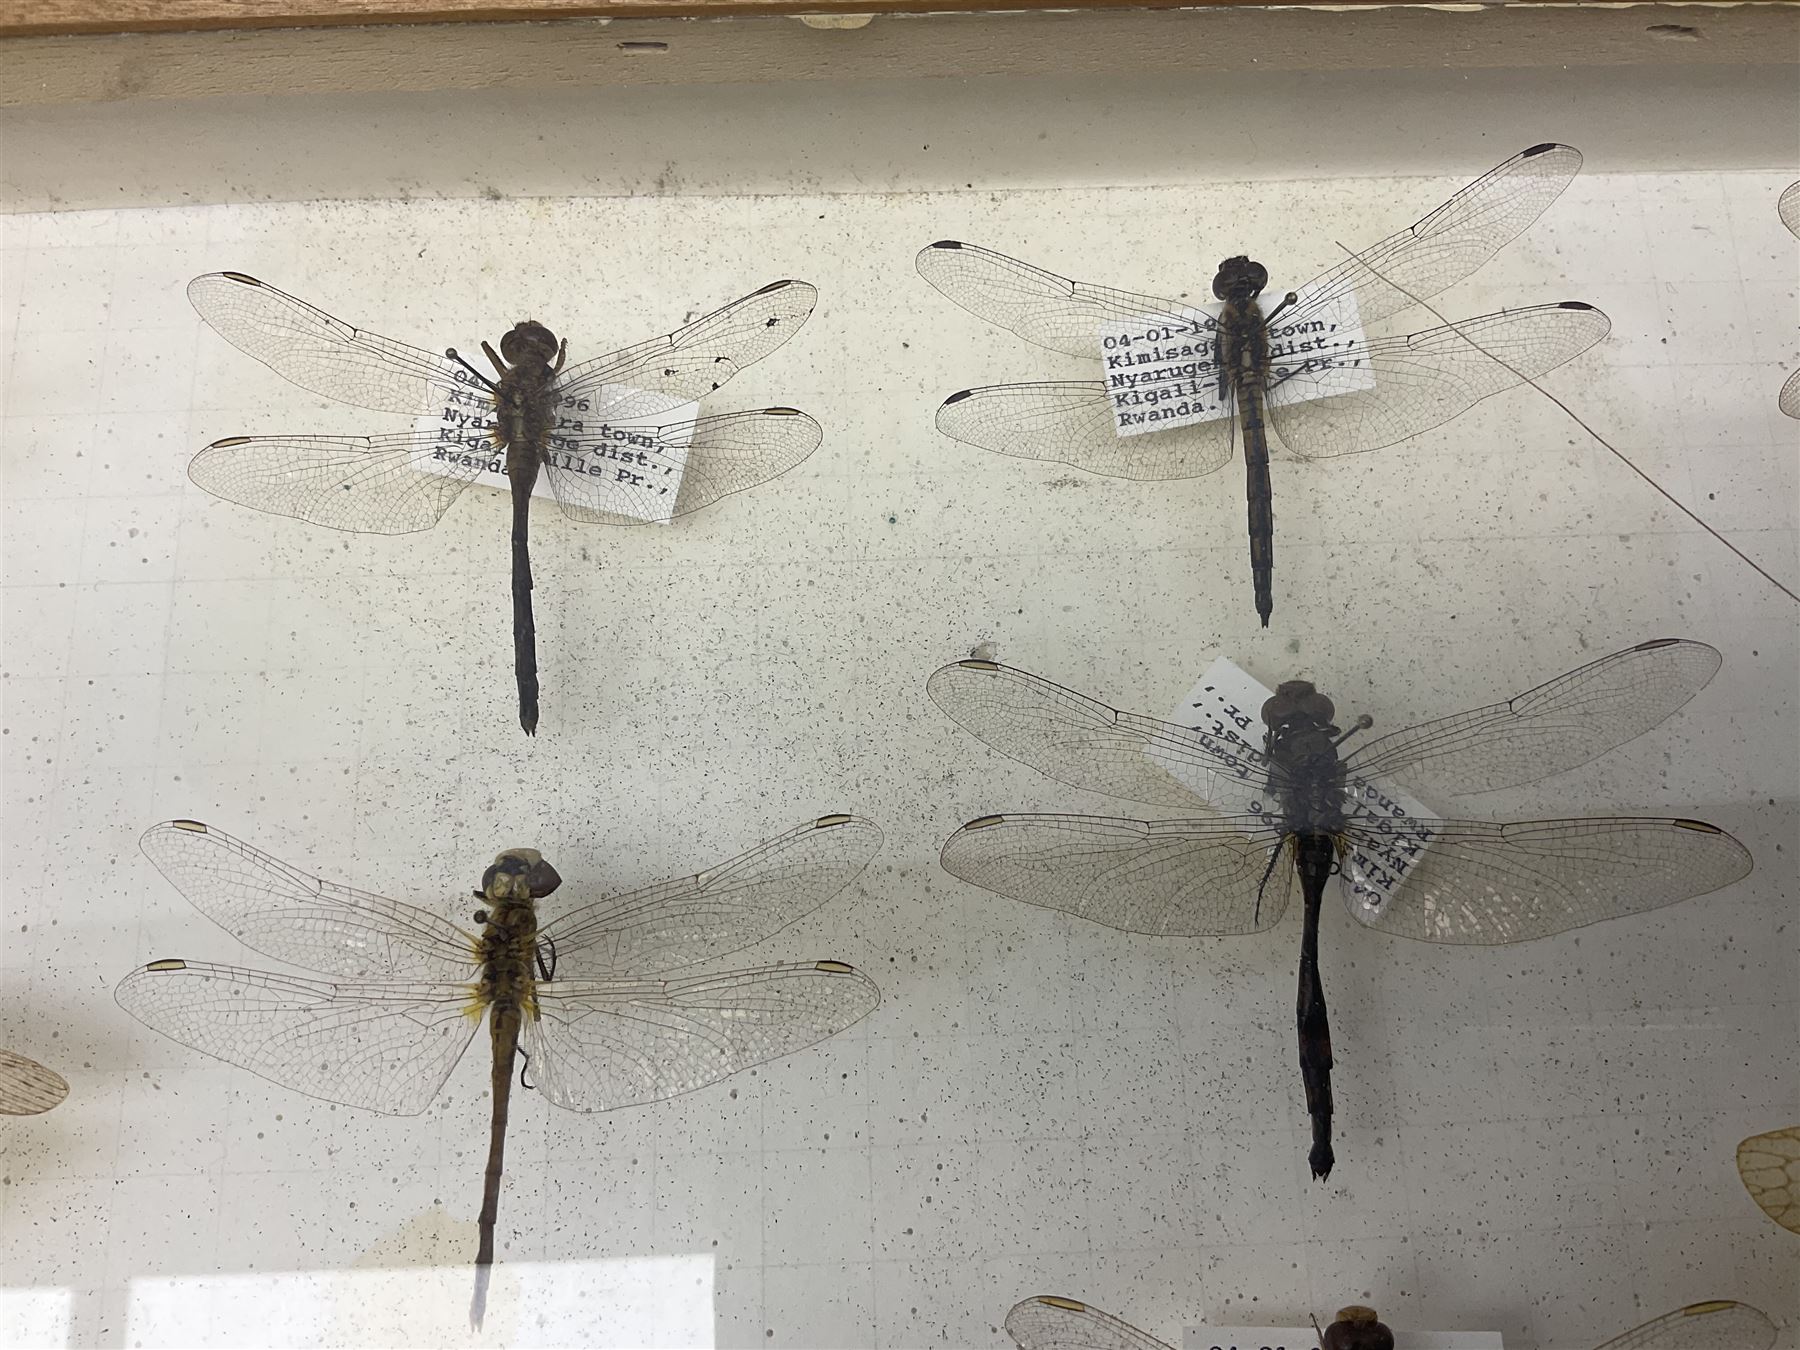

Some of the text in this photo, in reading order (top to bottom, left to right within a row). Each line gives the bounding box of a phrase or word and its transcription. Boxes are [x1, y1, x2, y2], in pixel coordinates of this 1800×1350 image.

[1103, 318, 1217, 349] 04-01-19
[1107, 320, 1336, 369] Kimisaga town,
[1270, 336, 1354, 359] dist.,
[1303, 358, 1360, 373] Pr.,
[1117, 401, 1216, 427] Rwanda.
[600, 423, 664, 454] town,
[593, 443, 673, 475] dist.,
[615, 468, 668, 495] Pr.,
[1204, 686, 1254, 730] Pr.,
[1192, 702, 1263, 763] dist.,
[1192, 726, 1250, 780] town,
